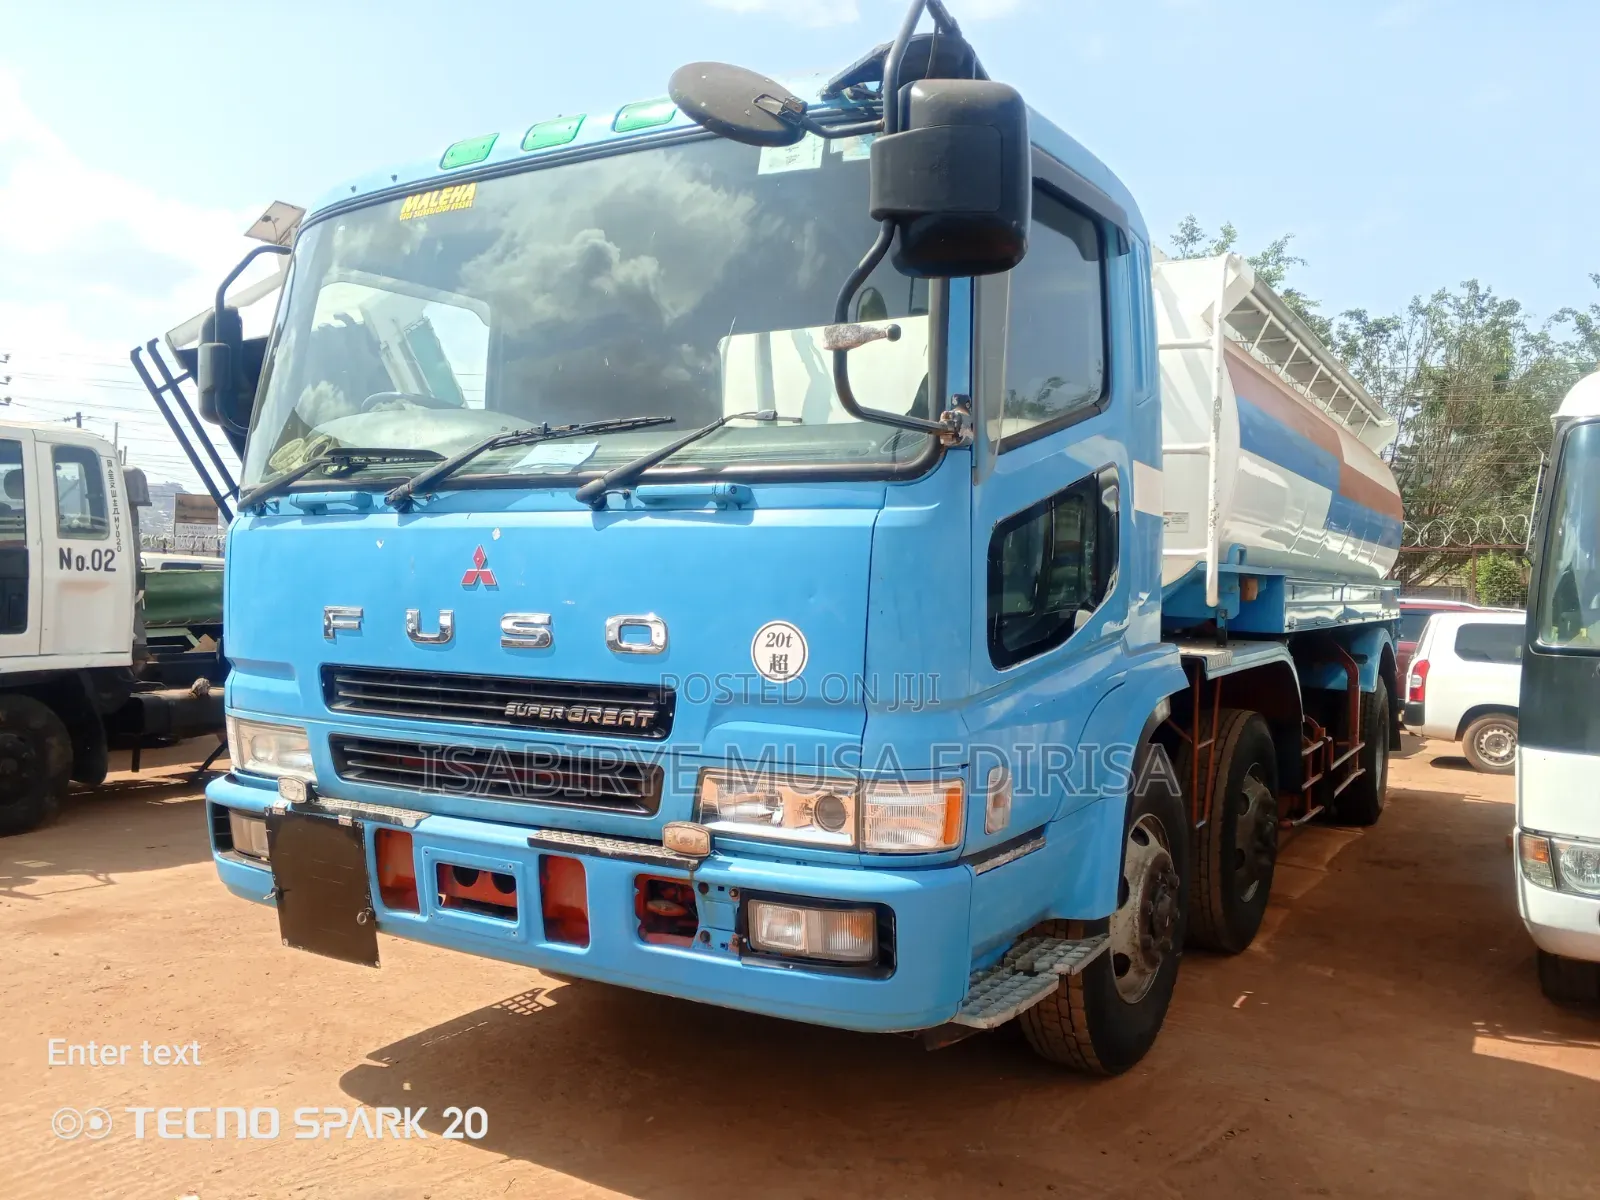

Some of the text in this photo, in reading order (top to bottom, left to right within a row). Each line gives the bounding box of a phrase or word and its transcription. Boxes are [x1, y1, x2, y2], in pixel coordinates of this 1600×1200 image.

[400, 182, 476, 214] MALEHA
[59, 547, 116, 572] No.02
[323, 605, 669, 654] FUSO
[765, 631, 793, 648] 20t
[769, 653, 789, 674] 超
[504, 702, 659, 728] SUPER GREAT
